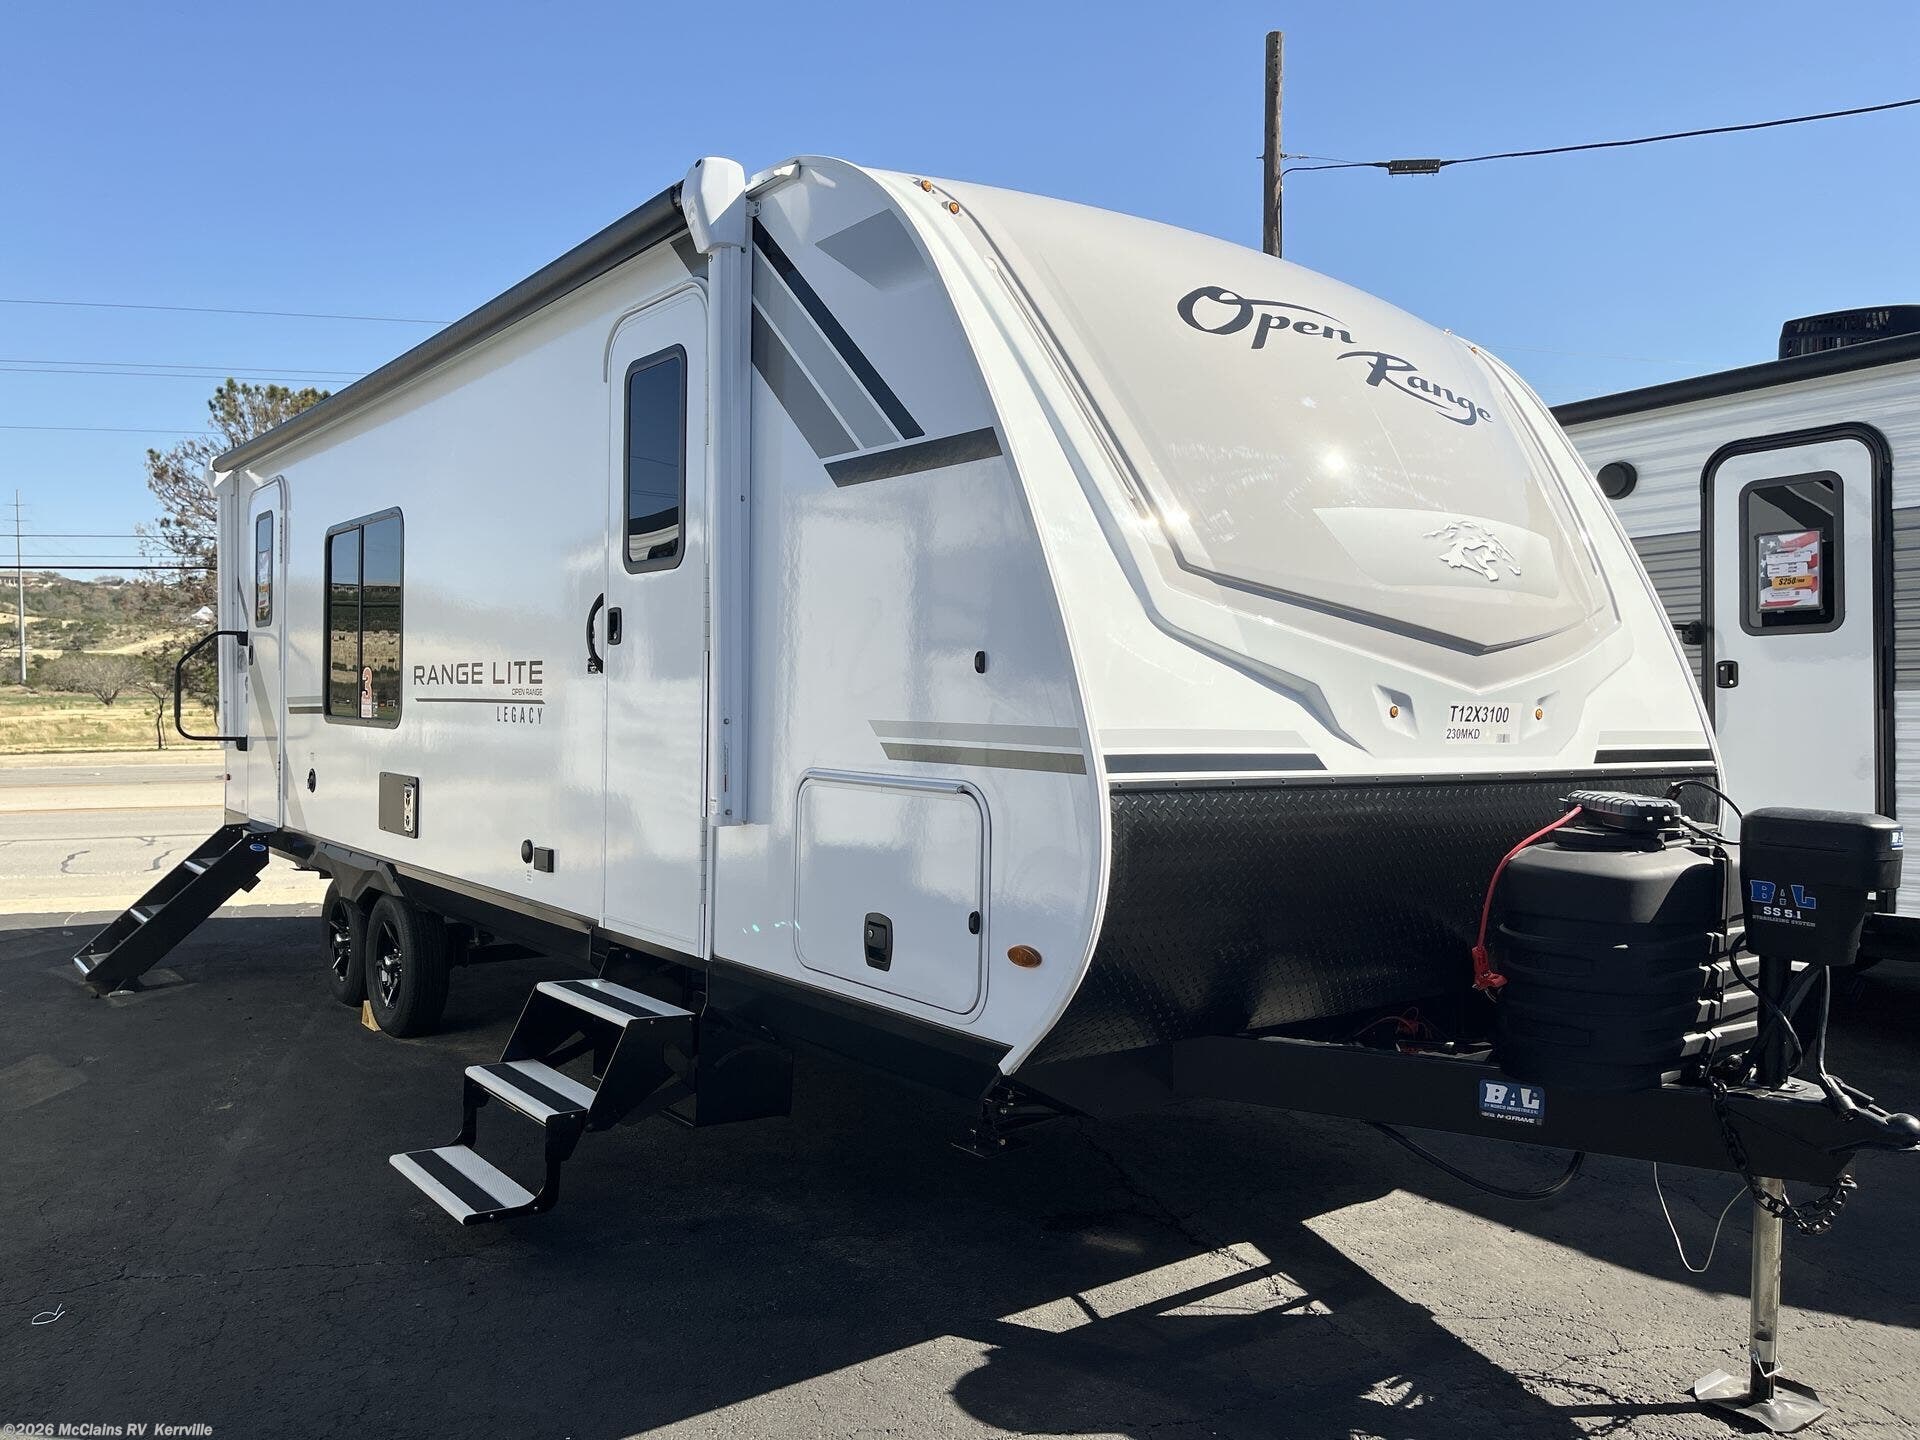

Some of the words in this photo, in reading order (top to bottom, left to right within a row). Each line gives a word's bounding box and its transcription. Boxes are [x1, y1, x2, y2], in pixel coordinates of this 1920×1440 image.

[1176, 285, 1358, 350] Open
[1336, 350, 1495, 426] Range
[413, 662, 484, 686] RANGE
[492, 660, 544, 685] LITE
[496, 705, 543, 725] LEGACY
[1450, 705, 1510, 723] T12X3100
[1446, 728, 1481, 740] 230MKD
[1750, 879, 1817, 910] BAL
[1484, 1083, 1540, 1110] BAL
